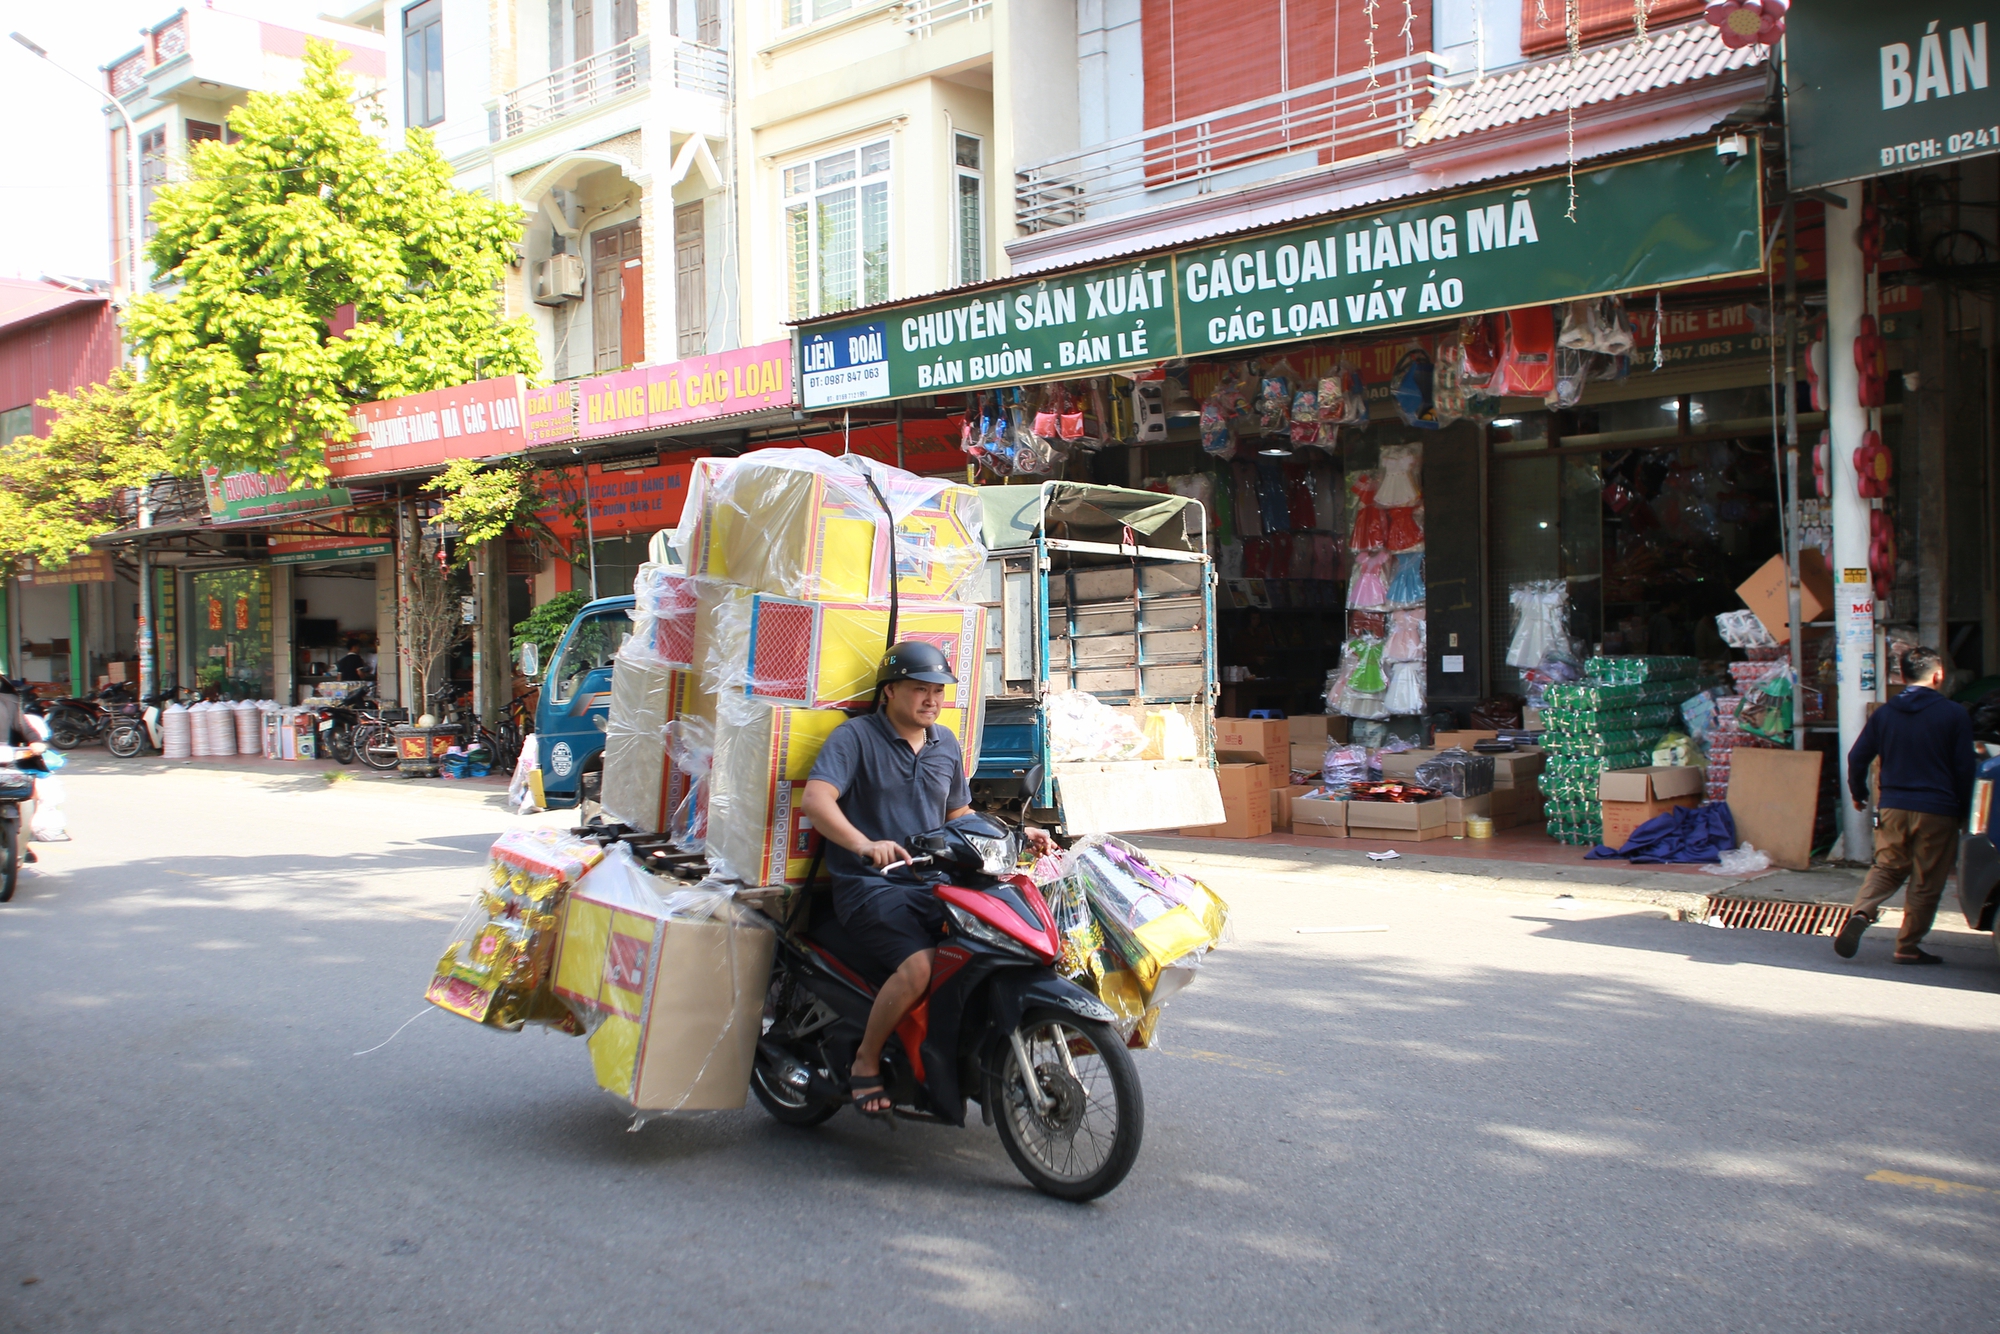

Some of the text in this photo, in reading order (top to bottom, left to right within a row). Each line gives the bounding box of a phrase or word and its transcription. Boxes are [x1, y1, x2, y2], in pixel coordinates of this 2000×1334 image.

[1880, 19, 1988, 111] BÁN
[1880, 138, 1942, 167] ĐTCH:
[1346, 215, 1458, 275] HÀNG
[1466, 188, 1538, 255] MÃ
[902, 261, 1166, 352] CHUYÊN SẢN XUẤT
[1208, 305, 1265, 345] CÁC
[1346, 280, 1410, 325] VÁY
[1417, 270, 1464, 313] ÁO
[803, 325, 883, 373] LIÊN ĐOÀI
[824, 373, 845, 386] 0987
[847, 371, 861, 383] 847
[864, 367, 879, 380] 063
[918, 355, 963, 389] BÁN
[970, 342, 1033, 381] BUÔN
[1059, 329, 1111, 367] BÁN
[1118, 319, 1149, 358] LẺ
[462, 397, 487, 434] CÁC
[489, 397, 520, 435] LOẠI
[588, 358, 783, 424] HÀNG MÃ CÁC LOẠI
[939, 949, 963, 960] HONDA
